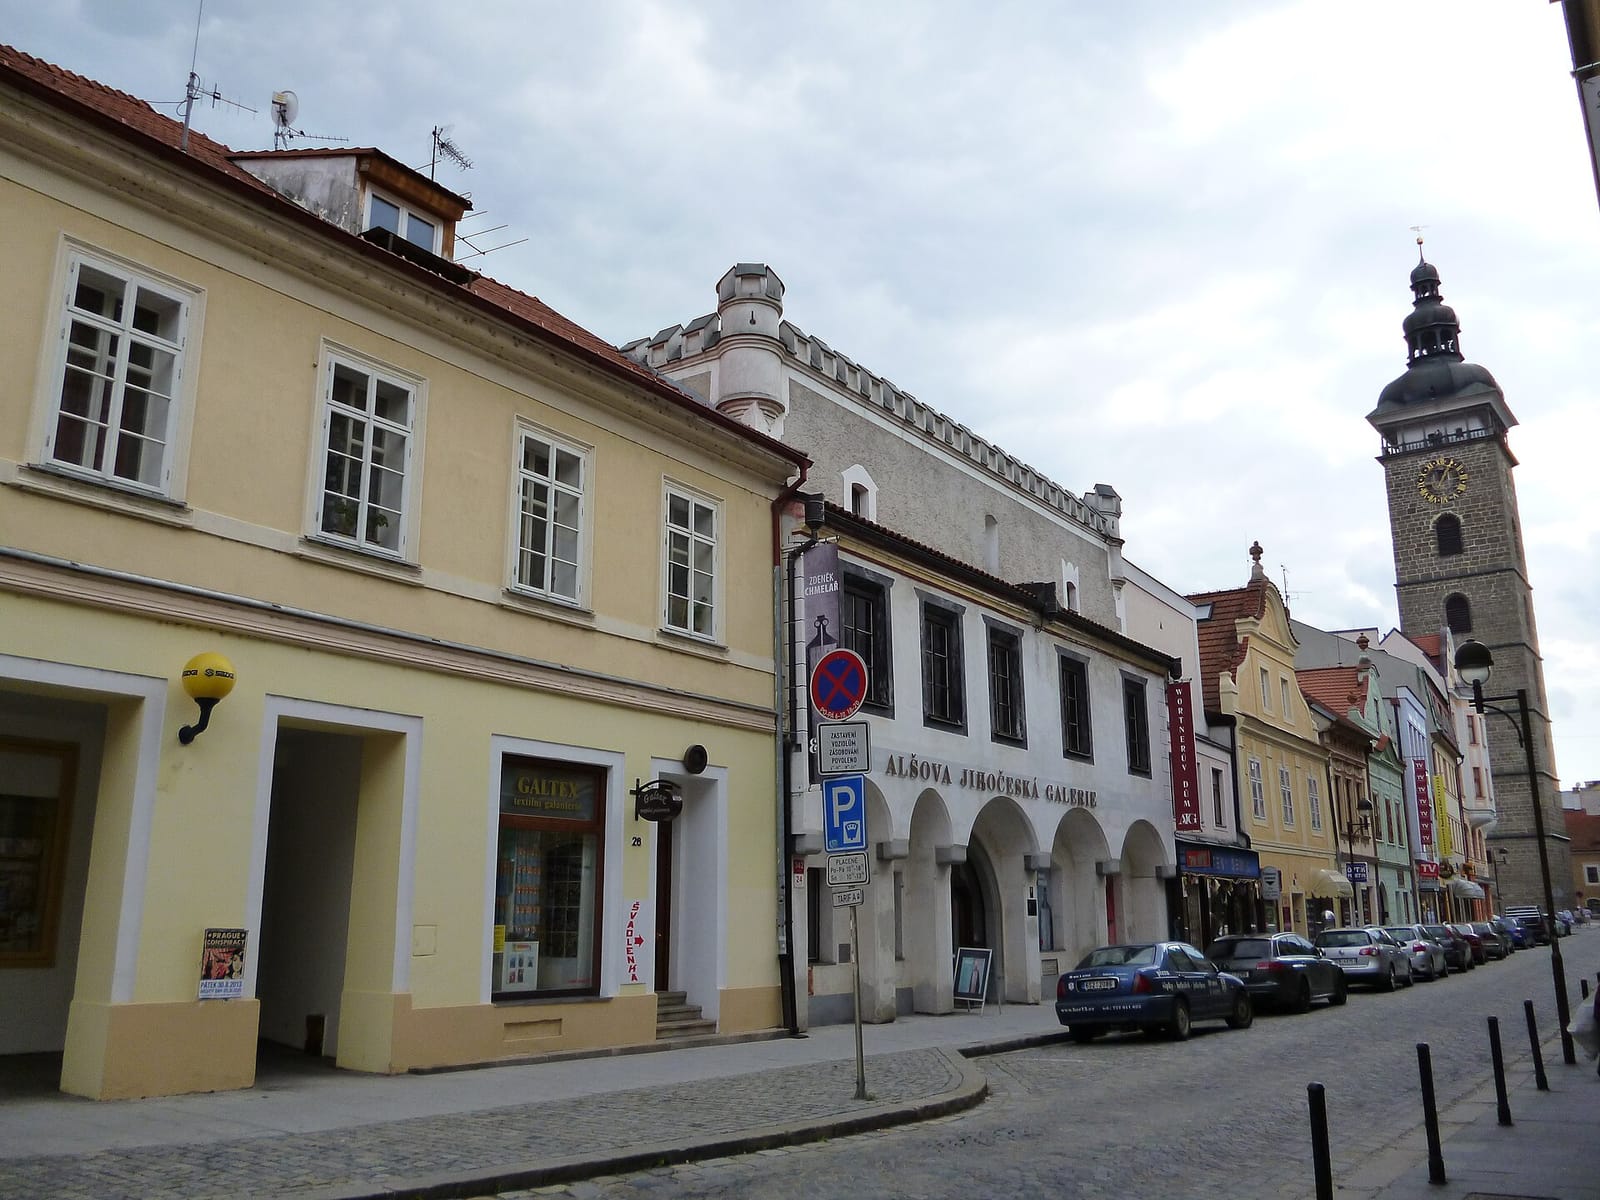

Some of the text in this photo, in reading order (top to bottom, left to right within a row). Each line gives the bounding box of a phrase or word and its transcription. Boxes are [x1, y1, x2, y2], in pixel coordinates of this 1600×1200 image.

[805, 581, 839, 596] CHMELAŘ
[518, 776, 577, 798] GALTEX
[885, 753, 1097, 808] ALŠOVA JIHOČESKÁ GALERIE
[1183, 780, 1191, 808] DŮM
[832, 786, 856, 828] P
[1421, 864, 1436, 873] TV
